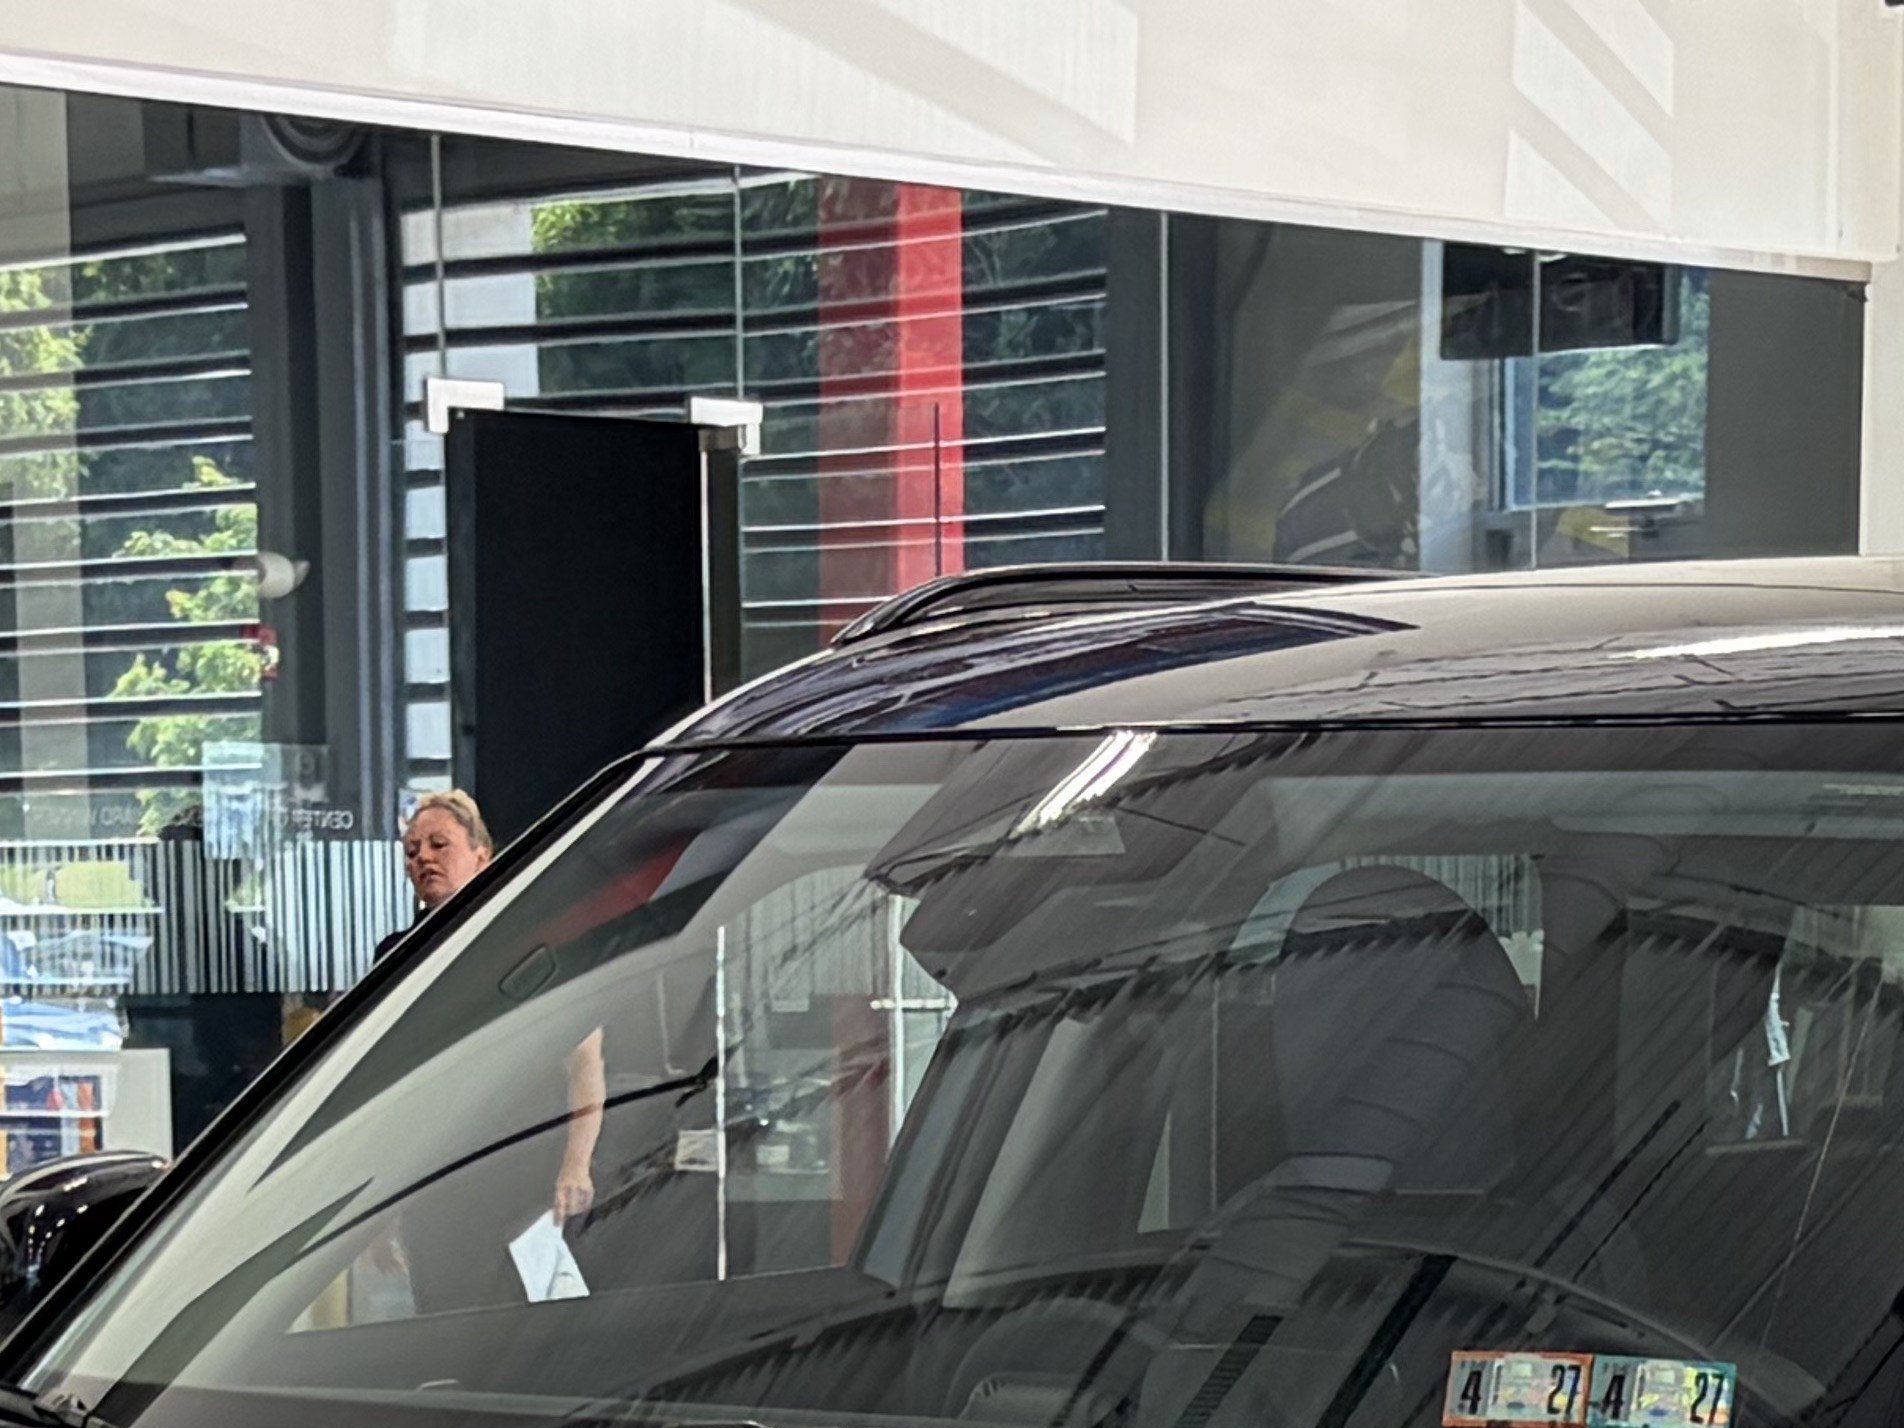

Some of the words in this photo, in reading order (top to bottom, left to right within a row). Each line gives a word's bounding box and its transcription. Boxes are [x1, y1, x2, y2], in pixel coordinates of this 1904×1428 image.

[1460, 1369, 1483, 1414] 4
[1547, 1363, 1582, 1420] 27
[1600, 1373, 1625, 1420] 4
[1690, 1371, 1724, 1425] 27
